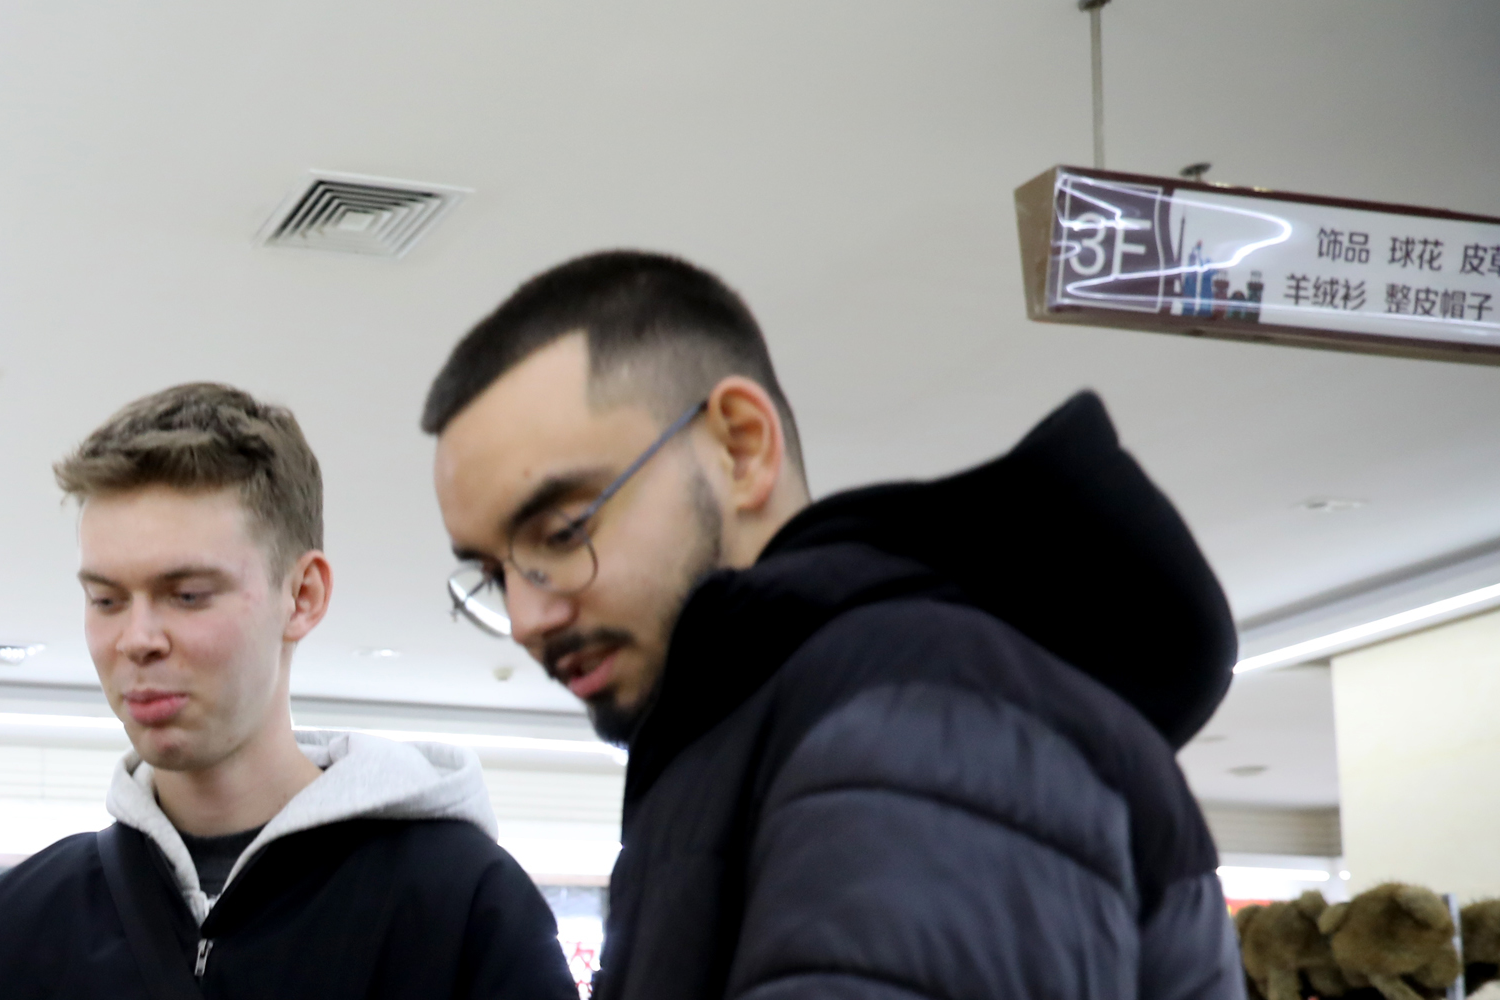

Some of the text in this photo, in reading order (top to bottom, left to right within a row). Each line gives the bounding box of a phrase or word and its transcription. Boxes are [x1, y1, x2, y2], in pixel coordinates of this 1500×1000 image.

[1069, 212, 1153, 277] 3F
[1317, 226, 1371, 264] 饰品
[1388, 237, 1444, 271] 球花
[1283, 273, 1493, 321] 羊绒衫 整皮帽子
